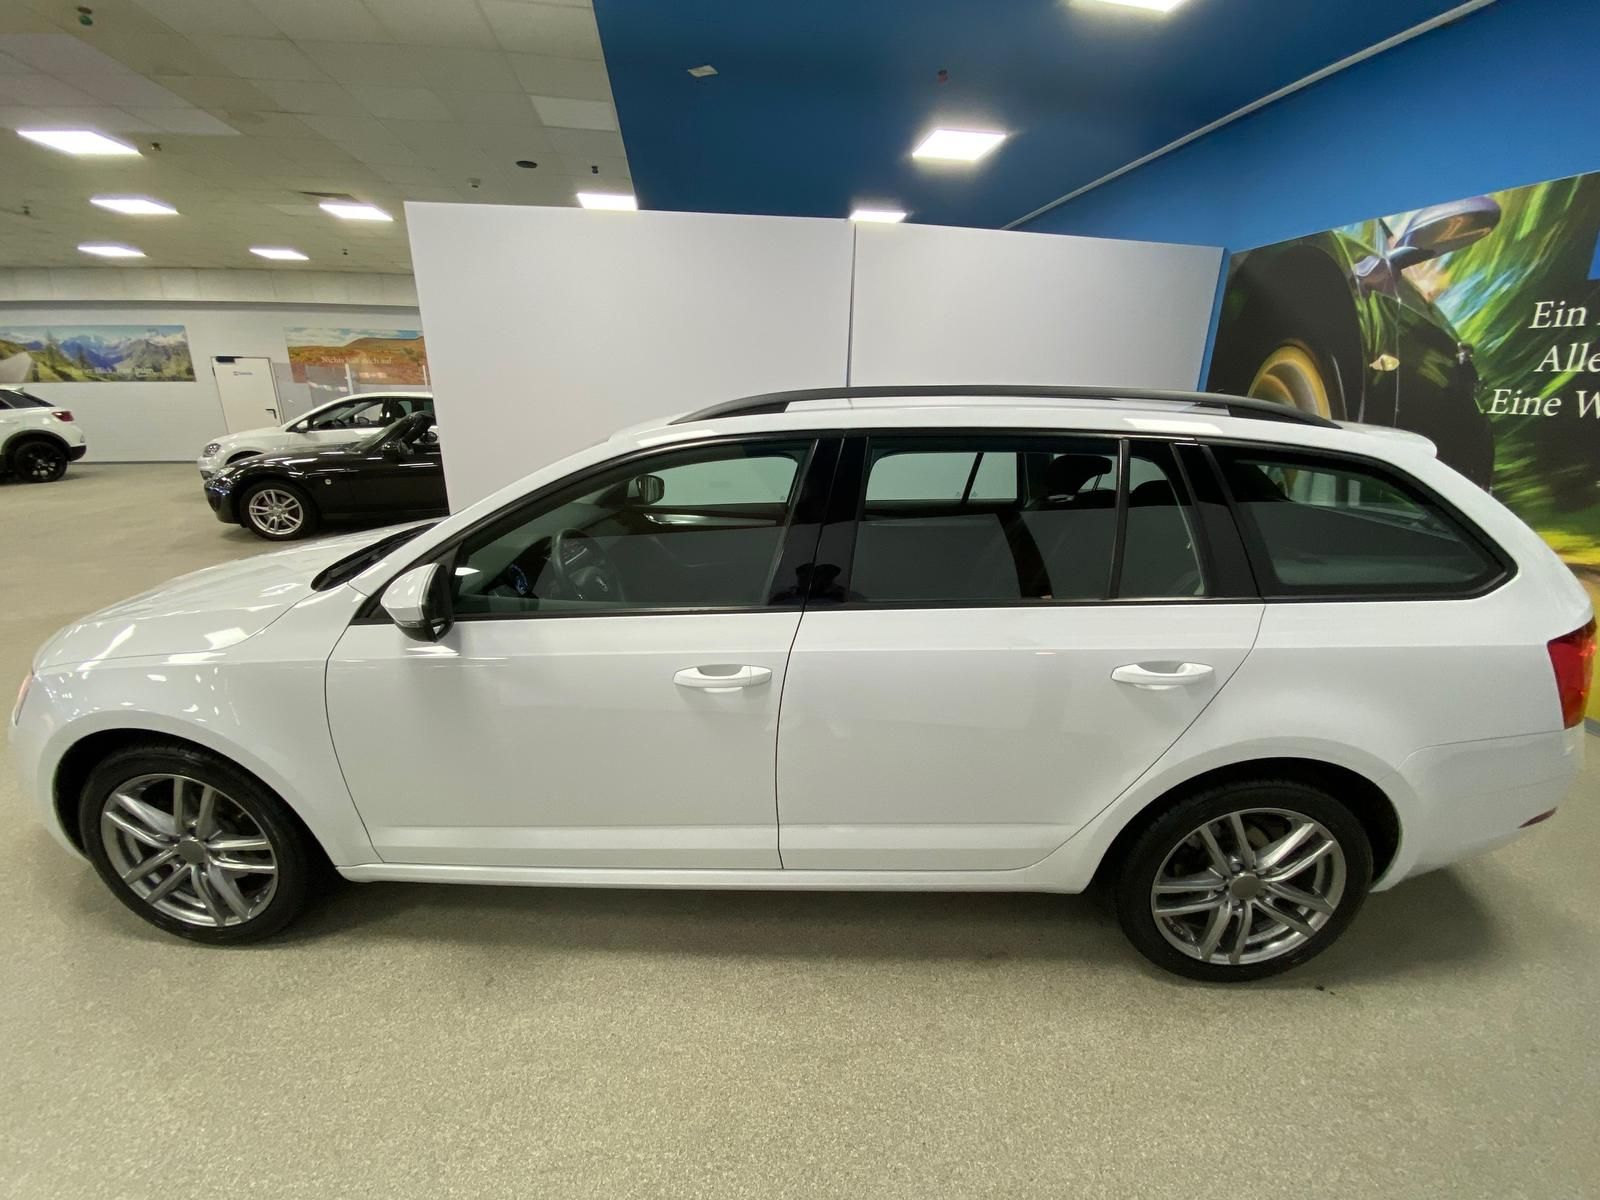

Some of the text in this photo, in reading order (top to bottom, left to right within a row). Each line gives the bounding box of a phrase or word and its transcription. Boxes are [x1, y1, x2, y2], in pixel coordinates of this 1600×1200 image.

[1528, 300, 1587, 329] Ein
[321, 356, 345, 364] Nichts
[1533, 342, 1600, 373] Alle
[1487, 388, 1562, 417] Eine
